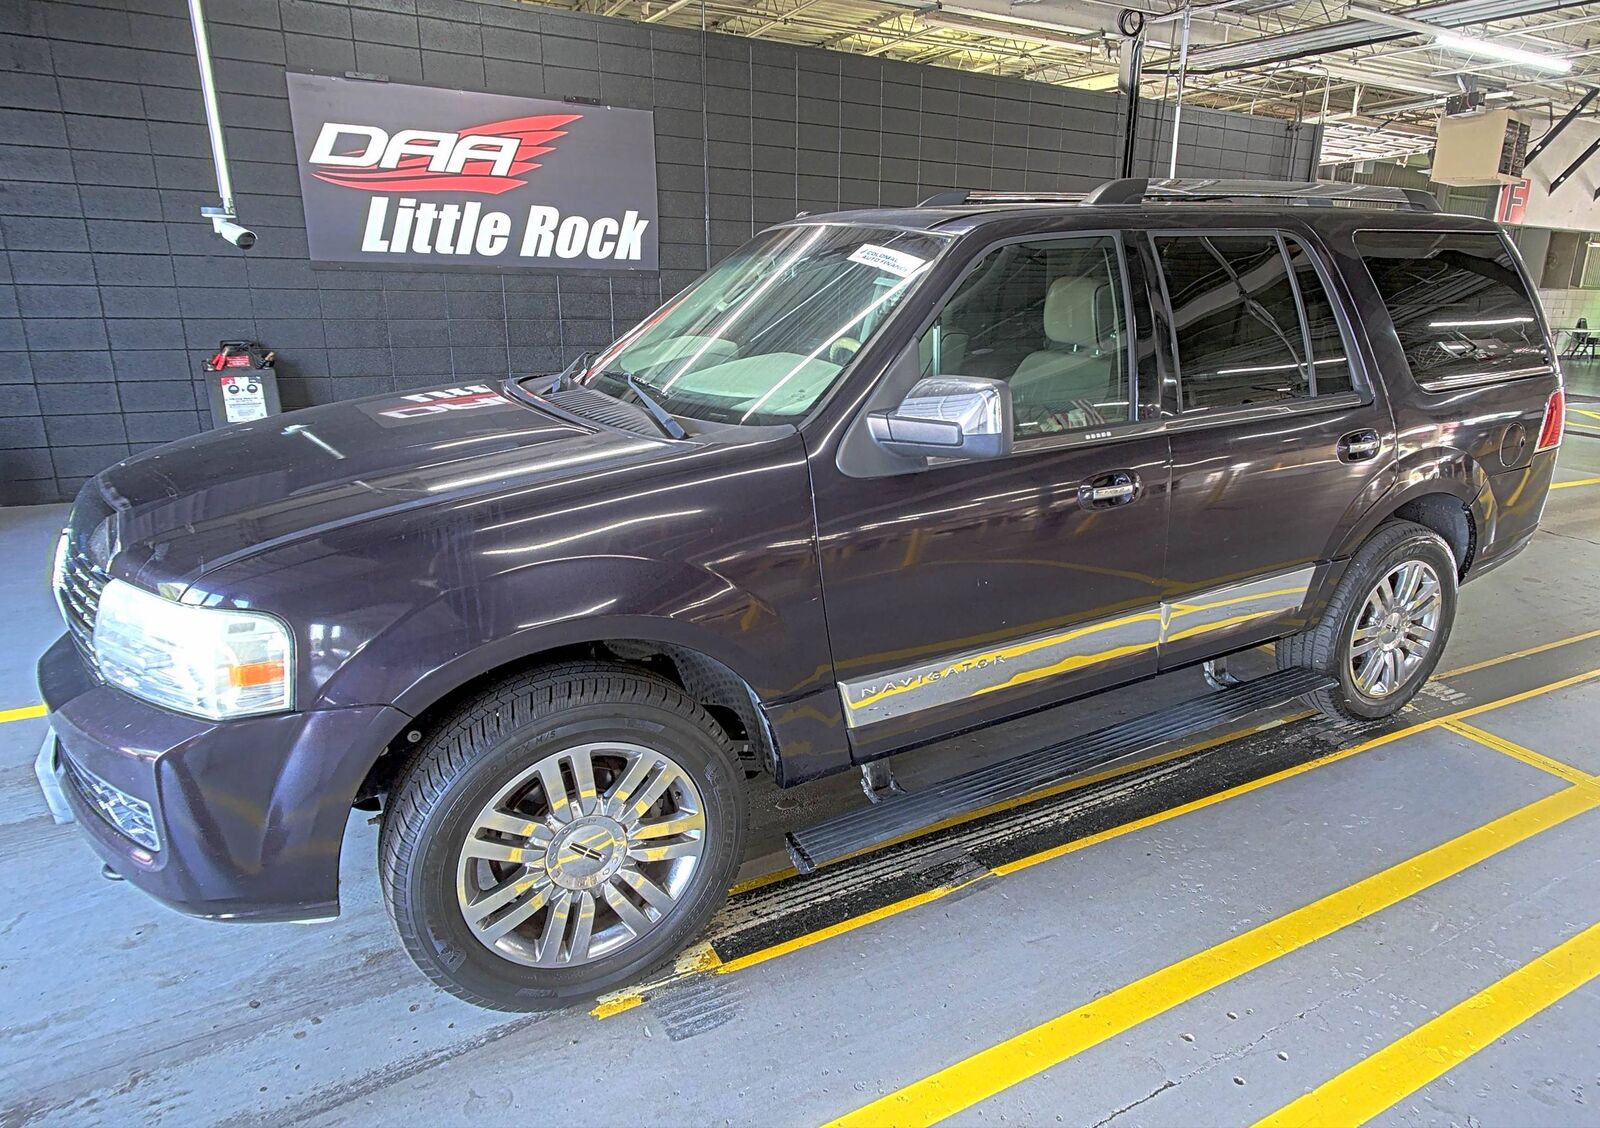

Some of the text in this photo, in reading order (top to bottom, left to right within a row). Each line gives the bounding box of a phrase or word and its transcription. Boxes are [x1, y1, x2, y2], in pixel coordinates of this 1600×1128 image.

[309, 122, 522, 176] DAA
[1503, 180, 1527, 222] F
[362, 197, 649, 261] Little Rock
[861, 255, 880, 263] AUTO
[861, 655, 1007, 698] NAVIGATOR
